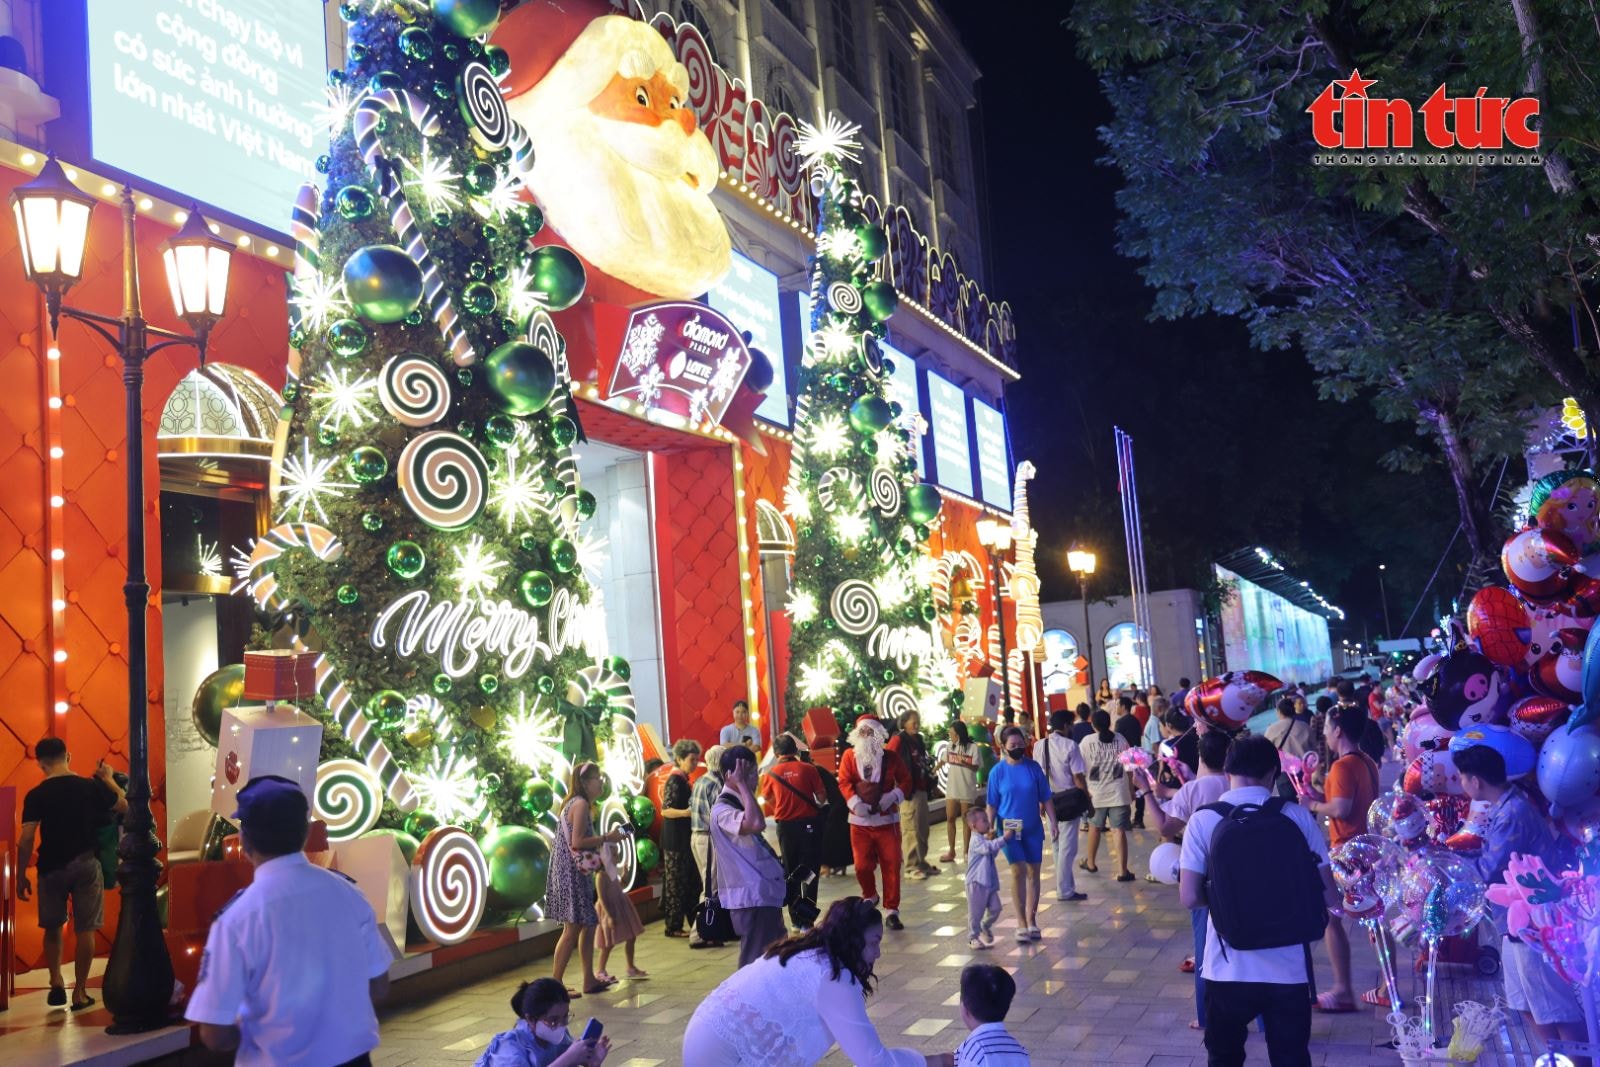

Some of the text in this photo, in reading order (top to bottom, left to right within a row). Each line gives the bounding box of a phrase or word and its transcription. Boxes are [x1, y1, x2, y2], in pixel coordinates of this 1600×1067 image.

[113, 30, 147, 61] có
[152, 48, 196, 86] sức
[200, 65, 244, 110] ảnh
[156, 11, 278, 96] cộng đồng
[197, 0, 252, 45] chạy
[255, 20, 283, 61] bộ
[113, 62, 317, 179] lớn nhất Việt Nam
[686, 358, 713, 379] LOTTE
[370, 590, 551, 679] Merry
